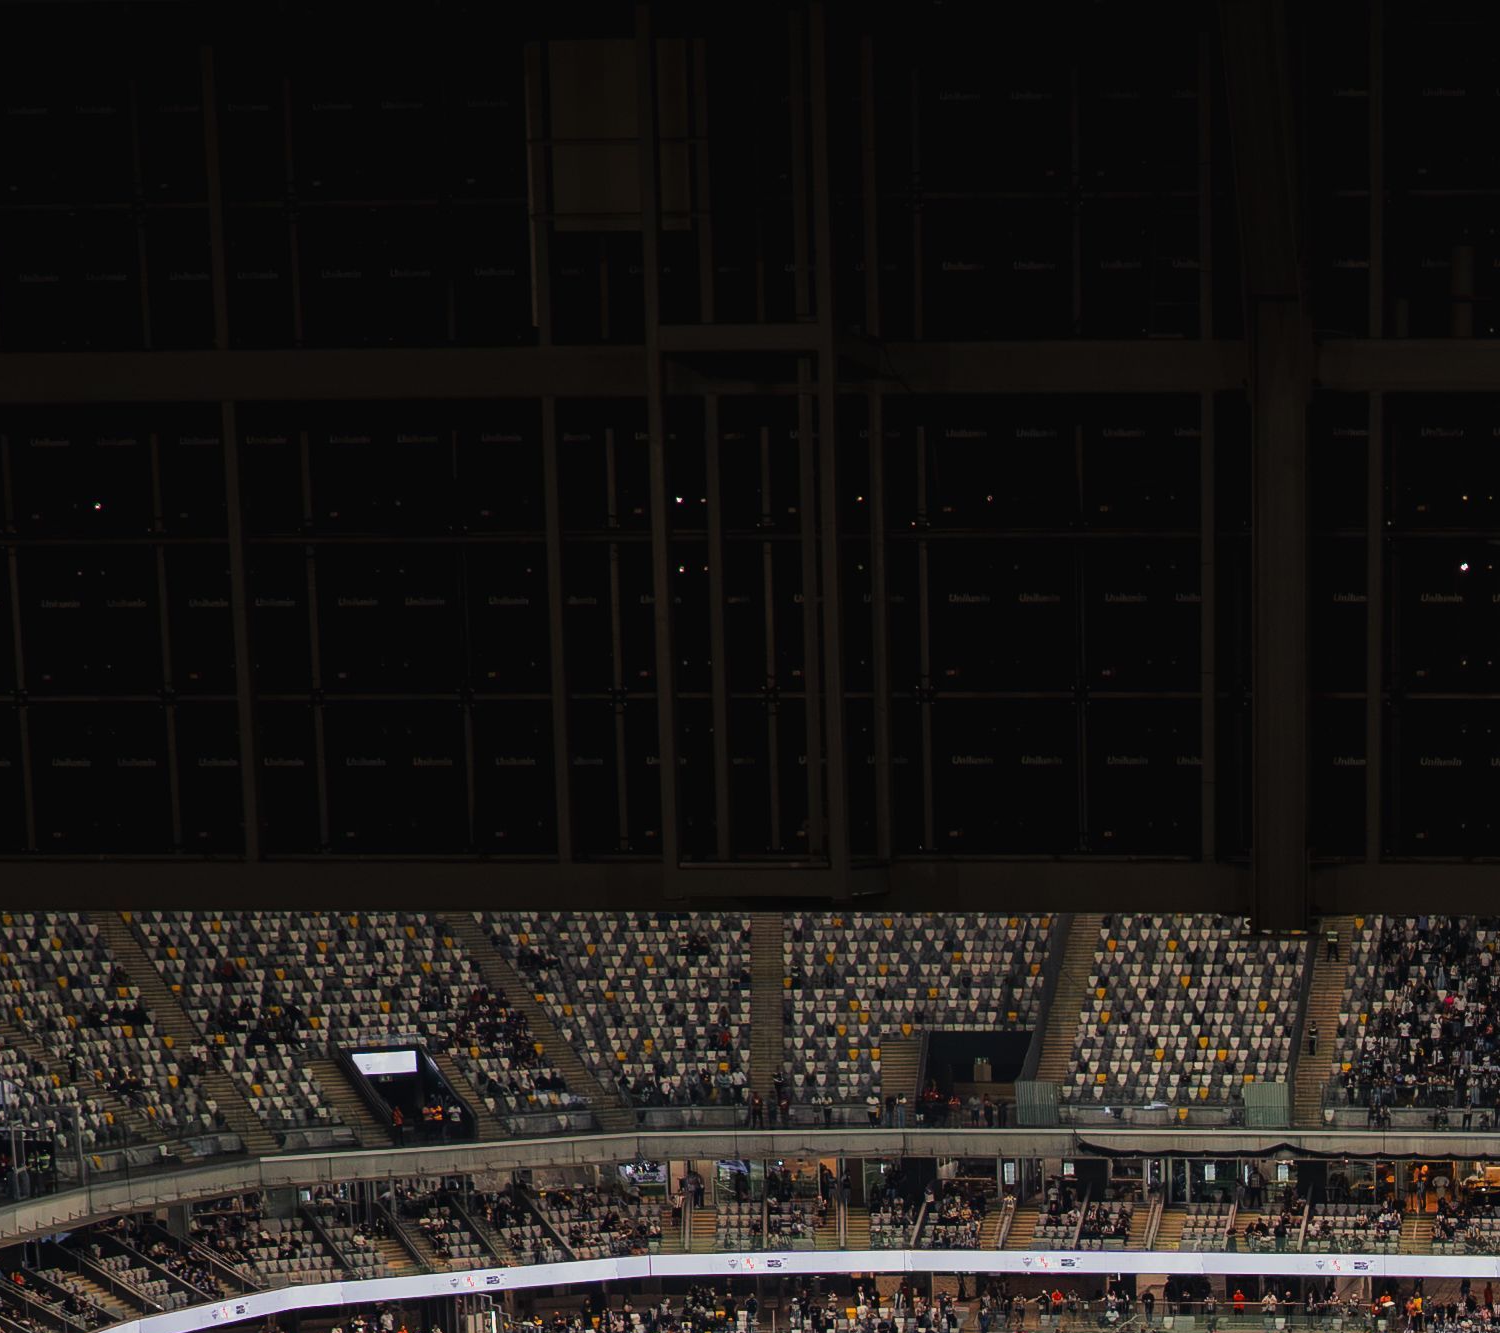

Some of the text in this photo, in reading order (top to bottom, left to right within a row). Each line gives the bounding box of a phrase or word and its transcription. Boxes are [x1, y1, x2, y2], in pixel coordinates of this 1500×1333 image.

[949, 592, 990, 604] Unilumin
[1421, 592, 1463, 603] Unilumin
[952, 755, 993, 765] Unilumin
[1021, 755, 1062, 766] Unilumin
[1420, 757, 1462, 767] Unilumin
